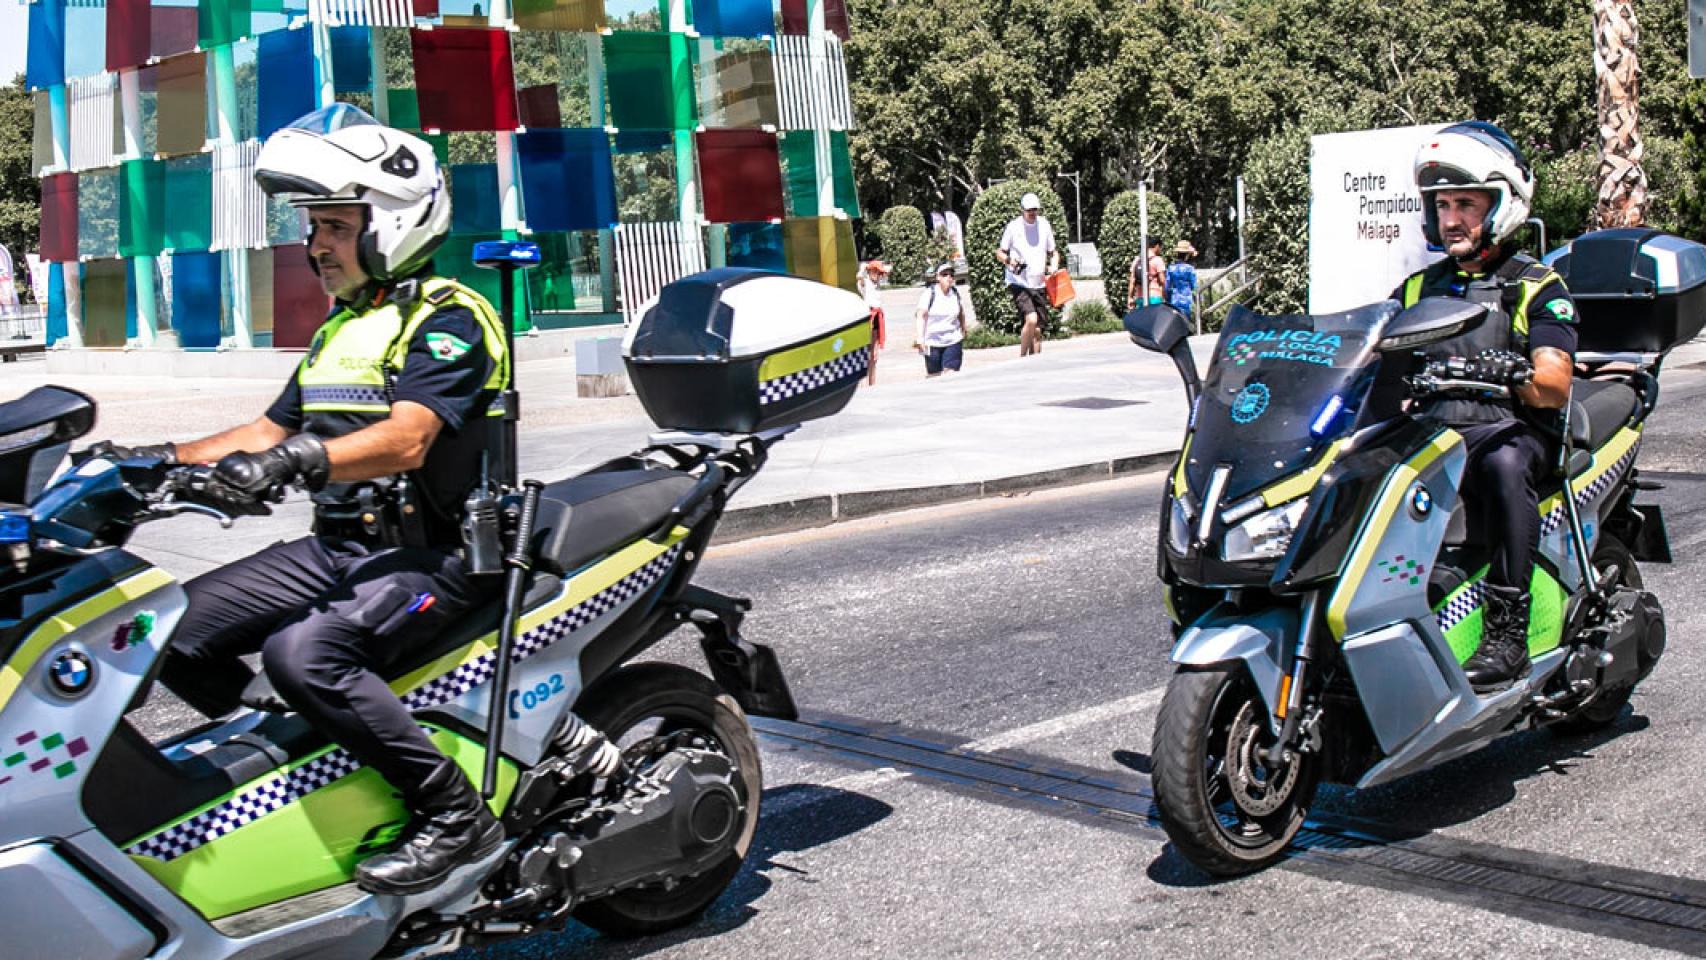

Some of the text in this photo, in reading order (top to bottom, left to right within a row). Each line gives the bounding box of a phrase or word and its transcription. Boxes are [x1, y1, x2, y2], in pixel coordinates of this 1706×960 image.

[1343, 172, 1386, 193] Centre
[1359, 192, 1421, 219] Pompidou
[1357, 220, 1400, 244] Málaga
[1278, 341, 1336, 356] LOCAL
[522, 673, 565, 710] 092
